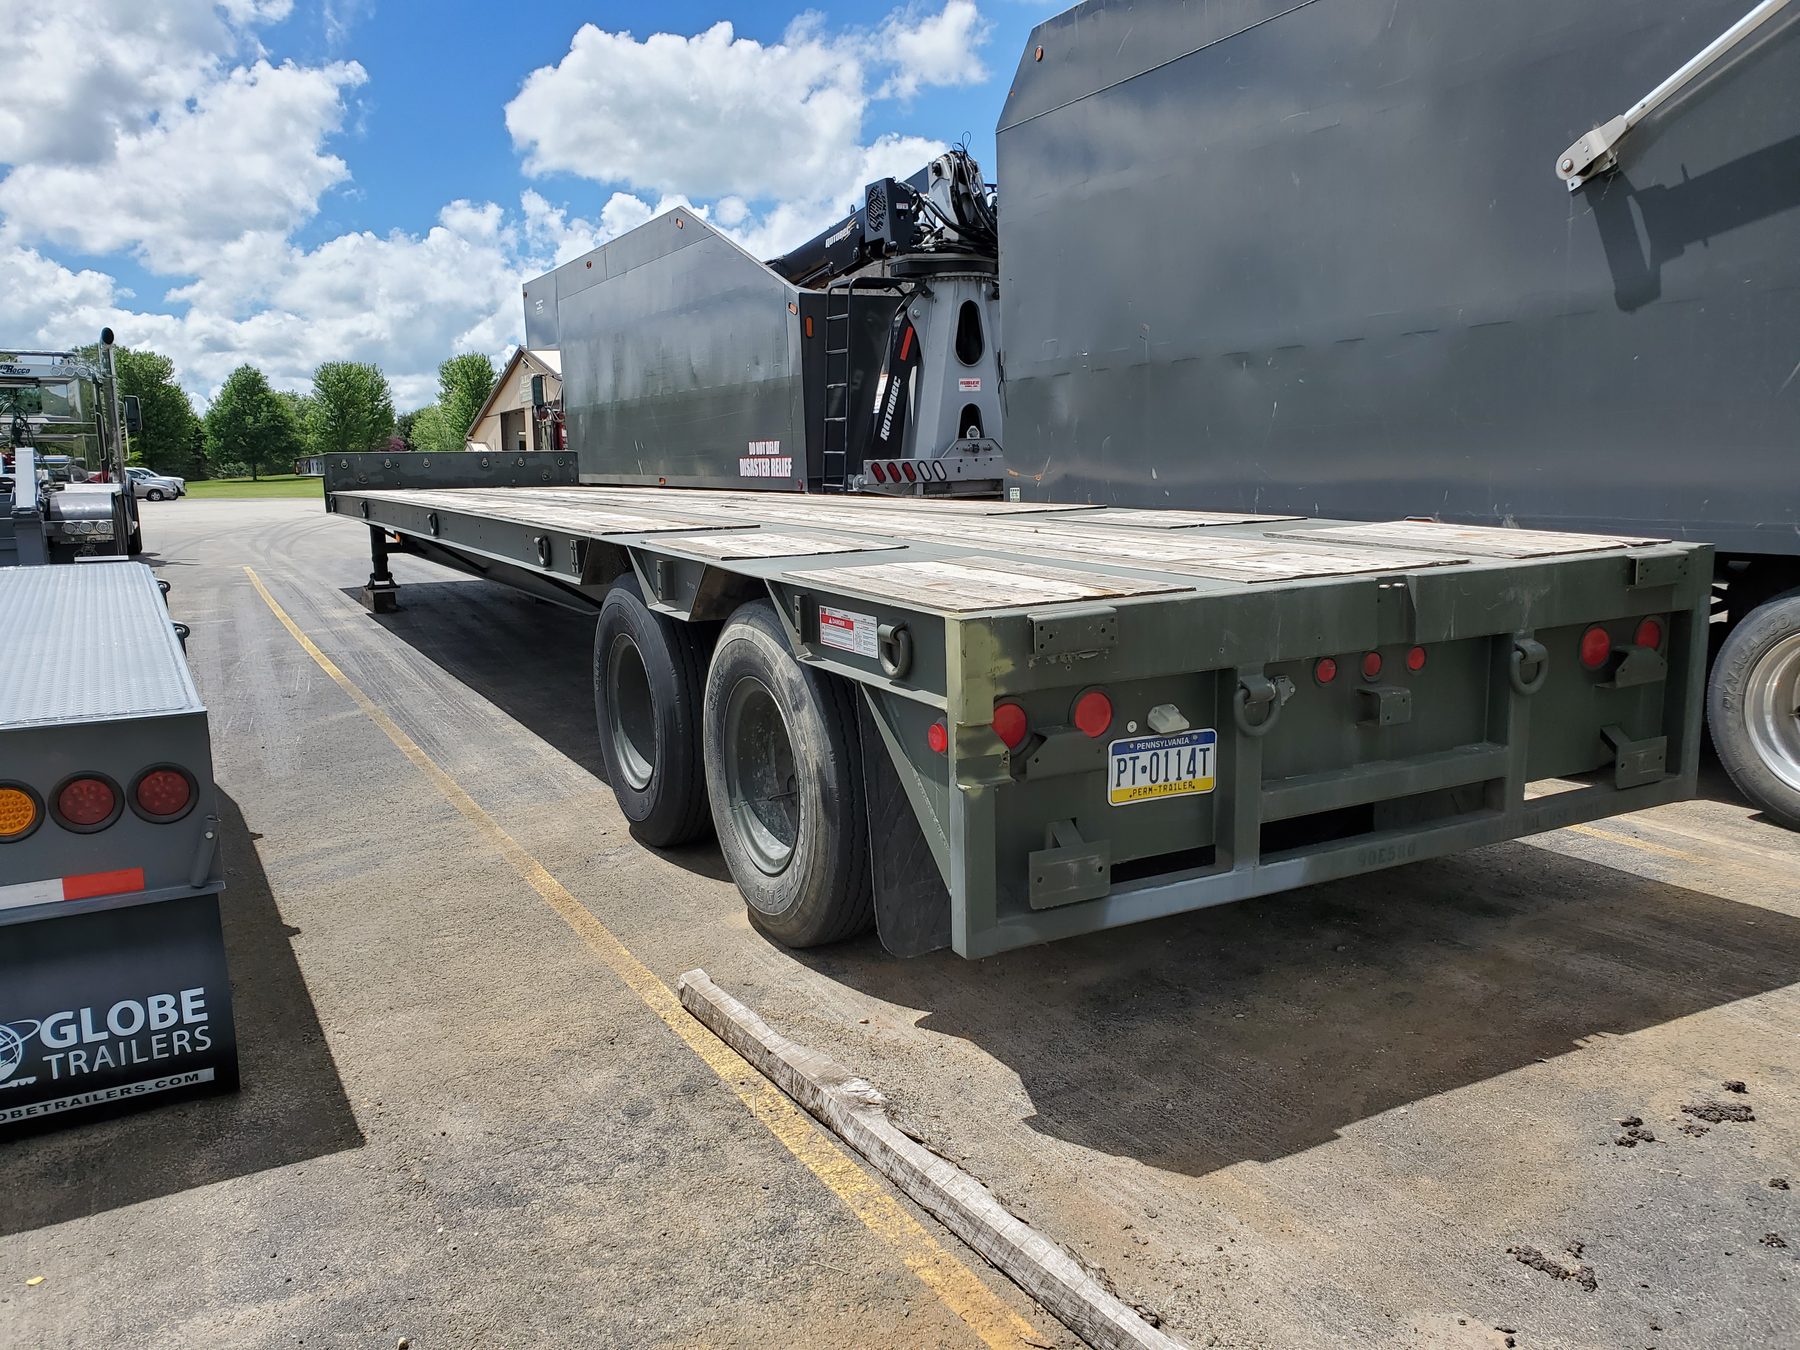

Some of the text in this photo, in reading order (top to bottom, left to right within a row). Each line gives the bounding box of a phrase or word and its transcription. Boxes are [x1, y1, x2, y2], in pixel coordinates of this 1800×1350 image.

[880, 375, 901, 441] ROTOBEC
[749, 441, 780, 455] DO NOT DELAY
[740, 457, 792, 477] DISASTER RELIEF
[1136, 736, 1190, 750] PENNSYLVANIA
[1132, 781, 1194, 797] PERM-TRAILER
[40, 986, 209, 1049] GLOBE
[42, 1025, 212, 1080] TRAILERS
